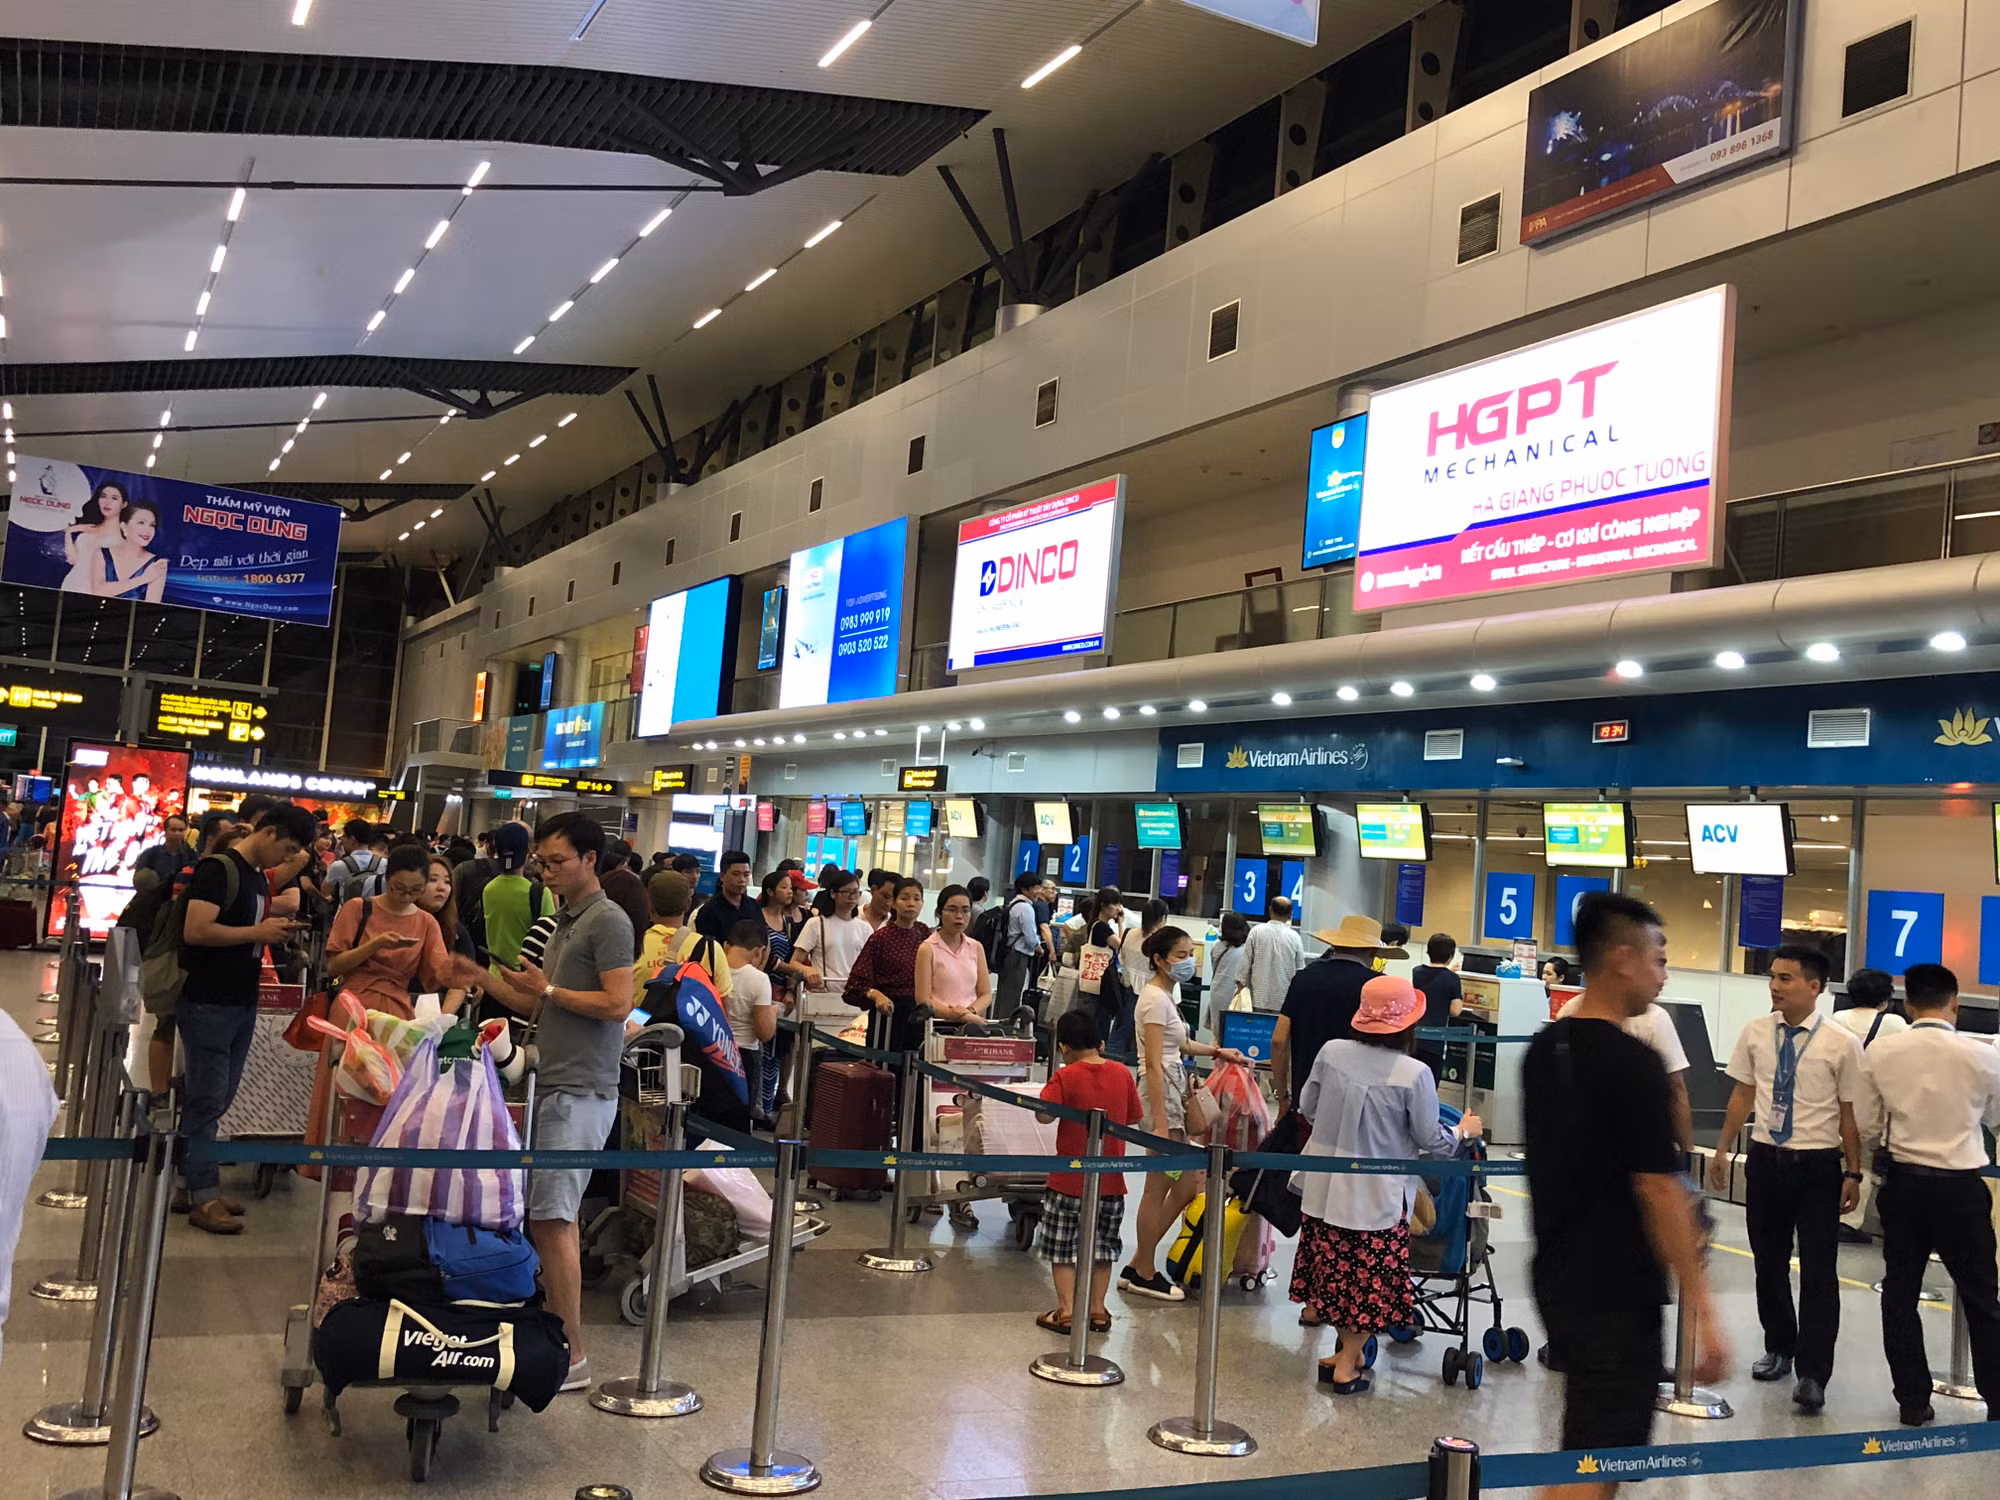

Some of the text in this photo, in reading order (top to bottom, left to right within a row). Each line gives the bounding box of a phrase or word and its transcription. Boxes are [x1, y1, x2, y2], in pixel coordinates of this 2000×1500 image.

[1709, 147, 1728, 162] 093
[1750, 130, 1774, 147] 1368
[1426, 360, 1620, 457] HGPT
[1424, 424, 1619, 484] MECHANICAL
[243, 501, 262, 513] MỸ
[263, 504, 291, 517] VIỆN
[1499, 481, 1555, 512] GIANG
[183, 504, 308, 541] NGỌC DUNG
[237, 553, 255, 565] với
[258, 551, 281, 563] thời
[284, 548, 309, 565] gian
[1485, 537, 1511, 560] CẤU
[243, 573, 274, 584] 1800
[276, 573, 306, 584] 6377
[998, 539, 1079, 593] DINCO
[840, 606, 891, 631] 0983 999 919
[838, 634, 889, 656] 0903 520 522
[1249, 746, 1348, 767] Vietnam Airlines
[1040, 814, 1055, 826] ACV
[1701, 824, 1738, 843] ACV
[1023, 850, 1031, 872] 1
[1070, 845, 1081, 873] 2
[1243, 871, 1257, 903] 3
[1290, 871, 1304, 908] 4
[1499, 887, 1518, 926] 5
[1891, 909, 1919, 958] 7
[711, 1017, 743, 1077] YONEX
[1882, 1435, 1956, 1453] Vietnam Airlines
[1599, 1454, 1687, 1472] Vietnam Airlines
